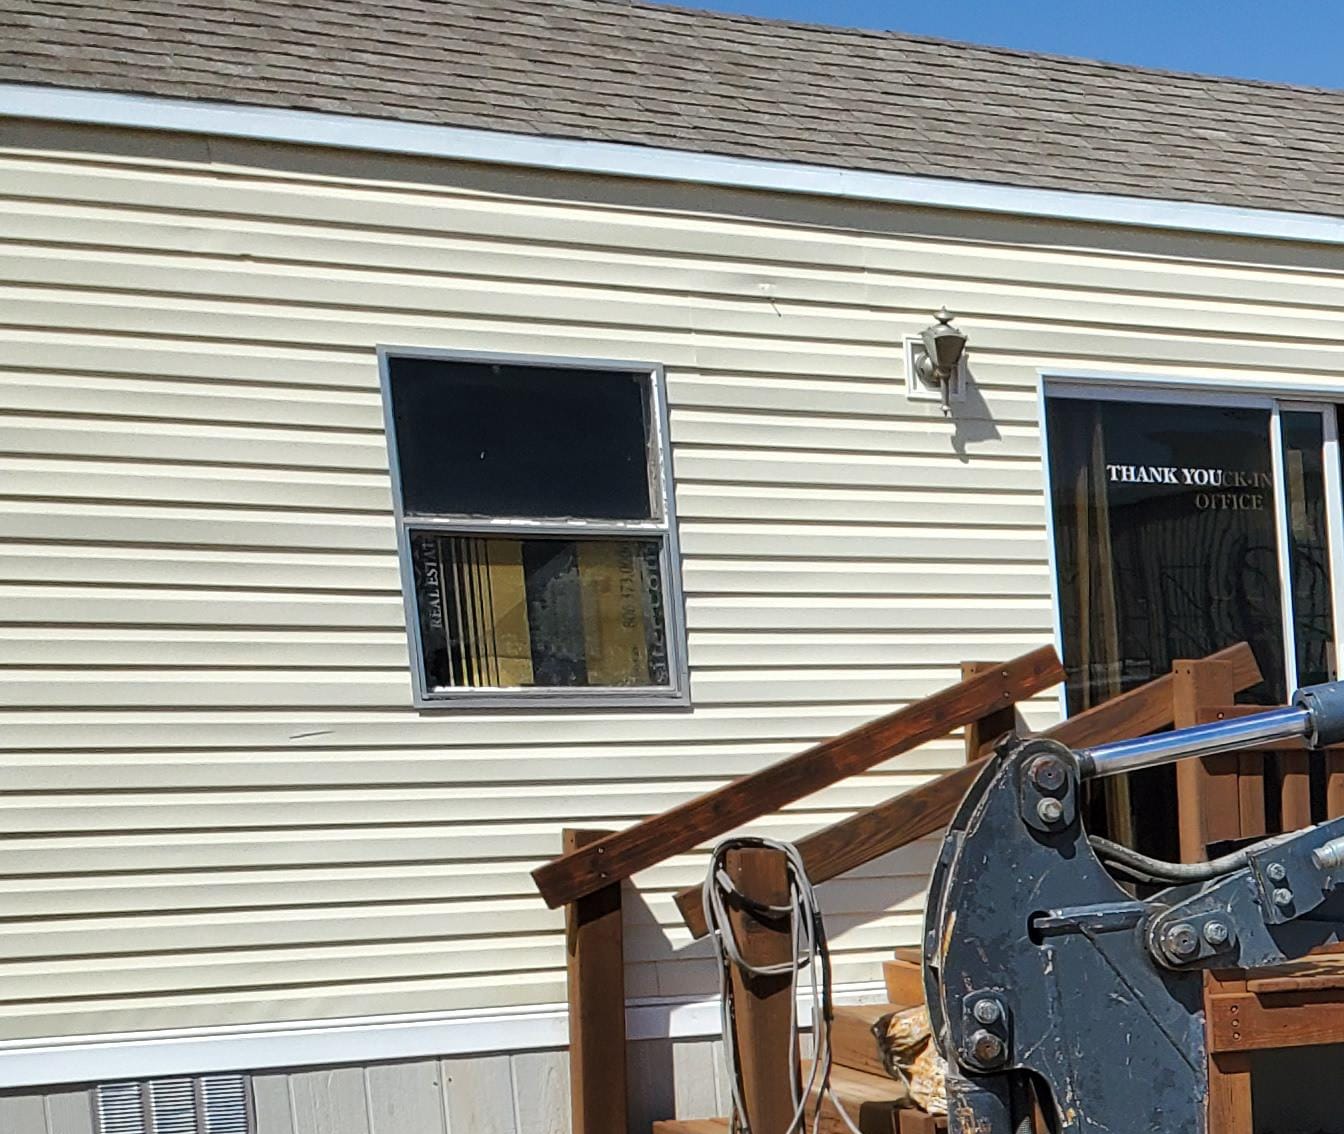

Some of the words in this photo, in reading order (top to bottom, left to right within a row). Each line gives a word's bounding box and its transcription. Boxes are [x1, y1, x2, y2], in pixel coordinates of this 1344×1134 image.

[1107, 465, 1178, 484] THANK
[1181, 468, 1222, 486] YOU
[1196, 494, 1264, 511] OFFICE
[428, 589, 442, 629] REAL
